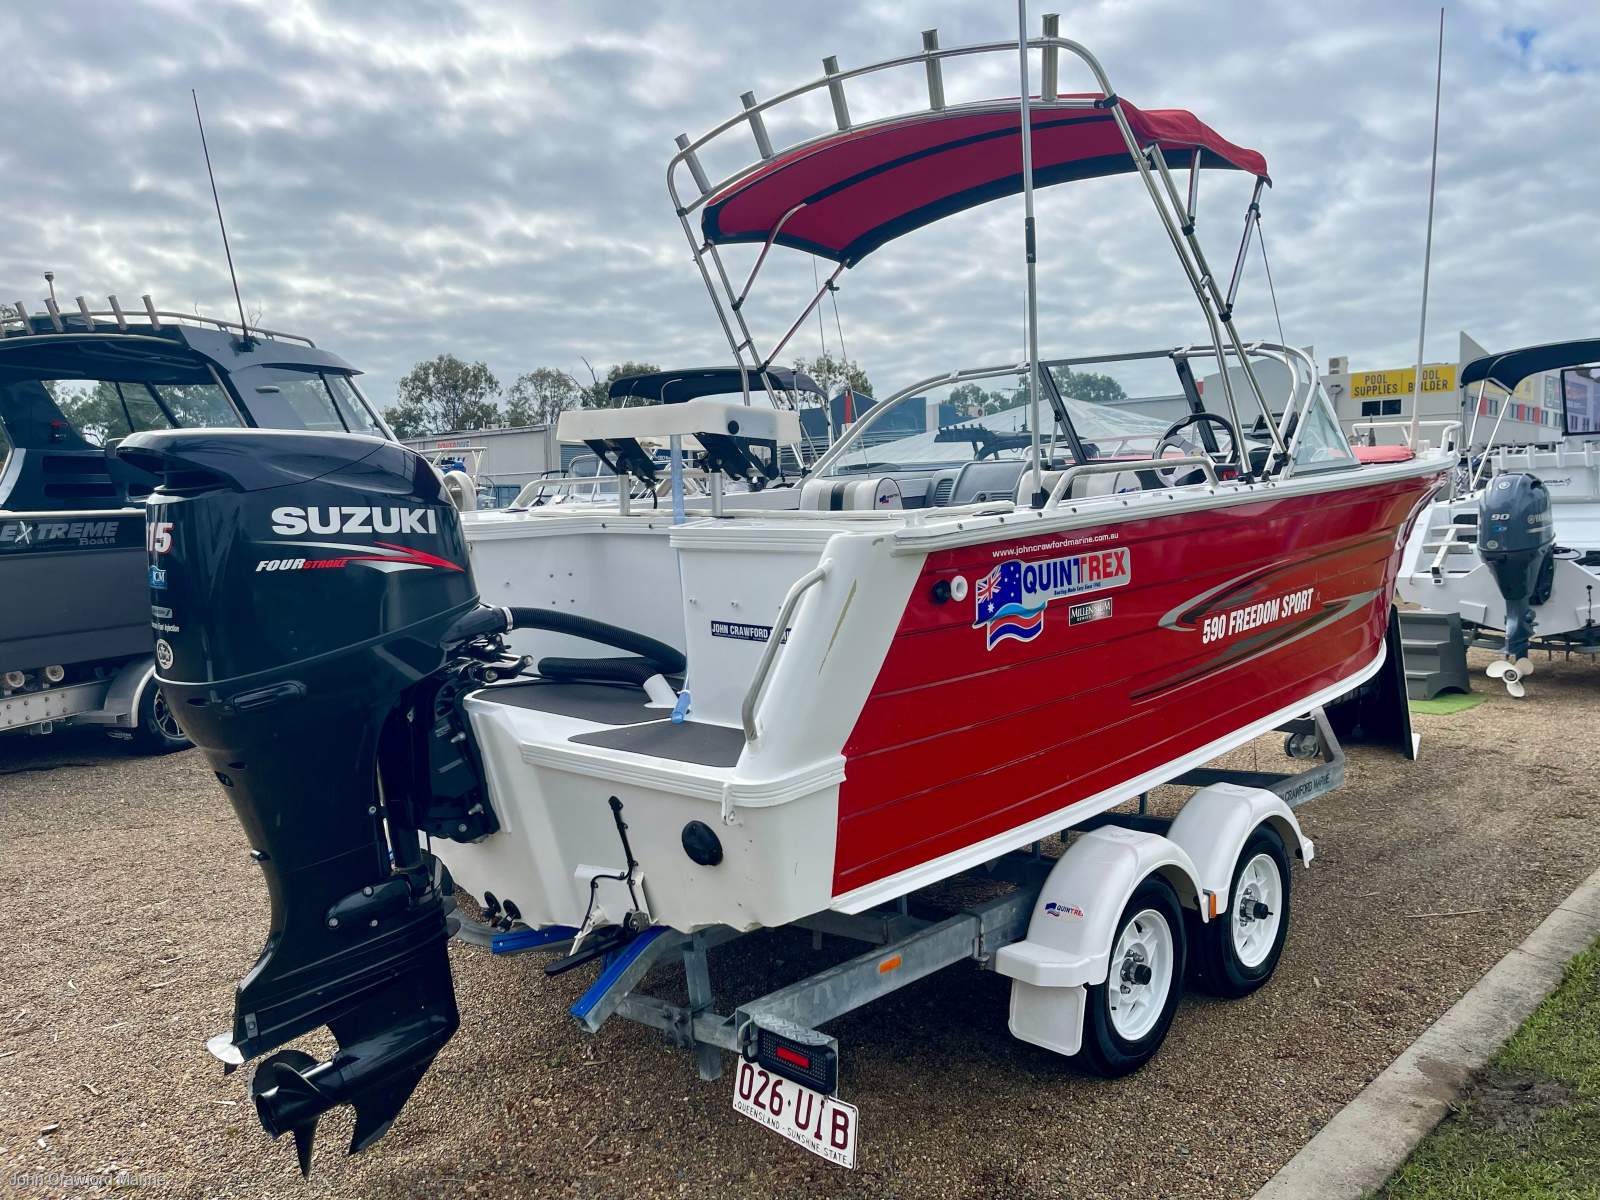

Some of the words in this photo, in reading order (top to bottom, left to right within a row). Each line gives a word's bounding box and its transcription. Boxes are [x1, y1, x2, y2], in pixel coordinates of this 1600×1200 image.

[1365, 374, 1387, 384] POOL
[1422, 370, 1440, 380] OOL
[1354, 383, 1398, 396] SUPPLIES
[1408, 380, 1448, 393] BILDER
[271, 506, 437, 535] SUZUKI
[0, 521, 119, 544] EXTREME
[992, 532, 1119, 558] www.johncrawfordmarine.com.au
[1023, 550, 1127, 595] QUINTREX
[1202, 614, 1227, 644] 590
[1228, 598, 1280, 636] FREEDOM
[1281, 588, 1314, 618] SPORT
[711, 623, 729, 634] JOHN
[730, 625, 768, 639] CRAWFORD
[1284, 781, 1313, 801] CRAWFORD
[737, 1101, 780, 1130] QUEENSLAND
[787, 1127, 821, 1152] SUNSHINE
[824, 1147, 848, 1164] STATE
